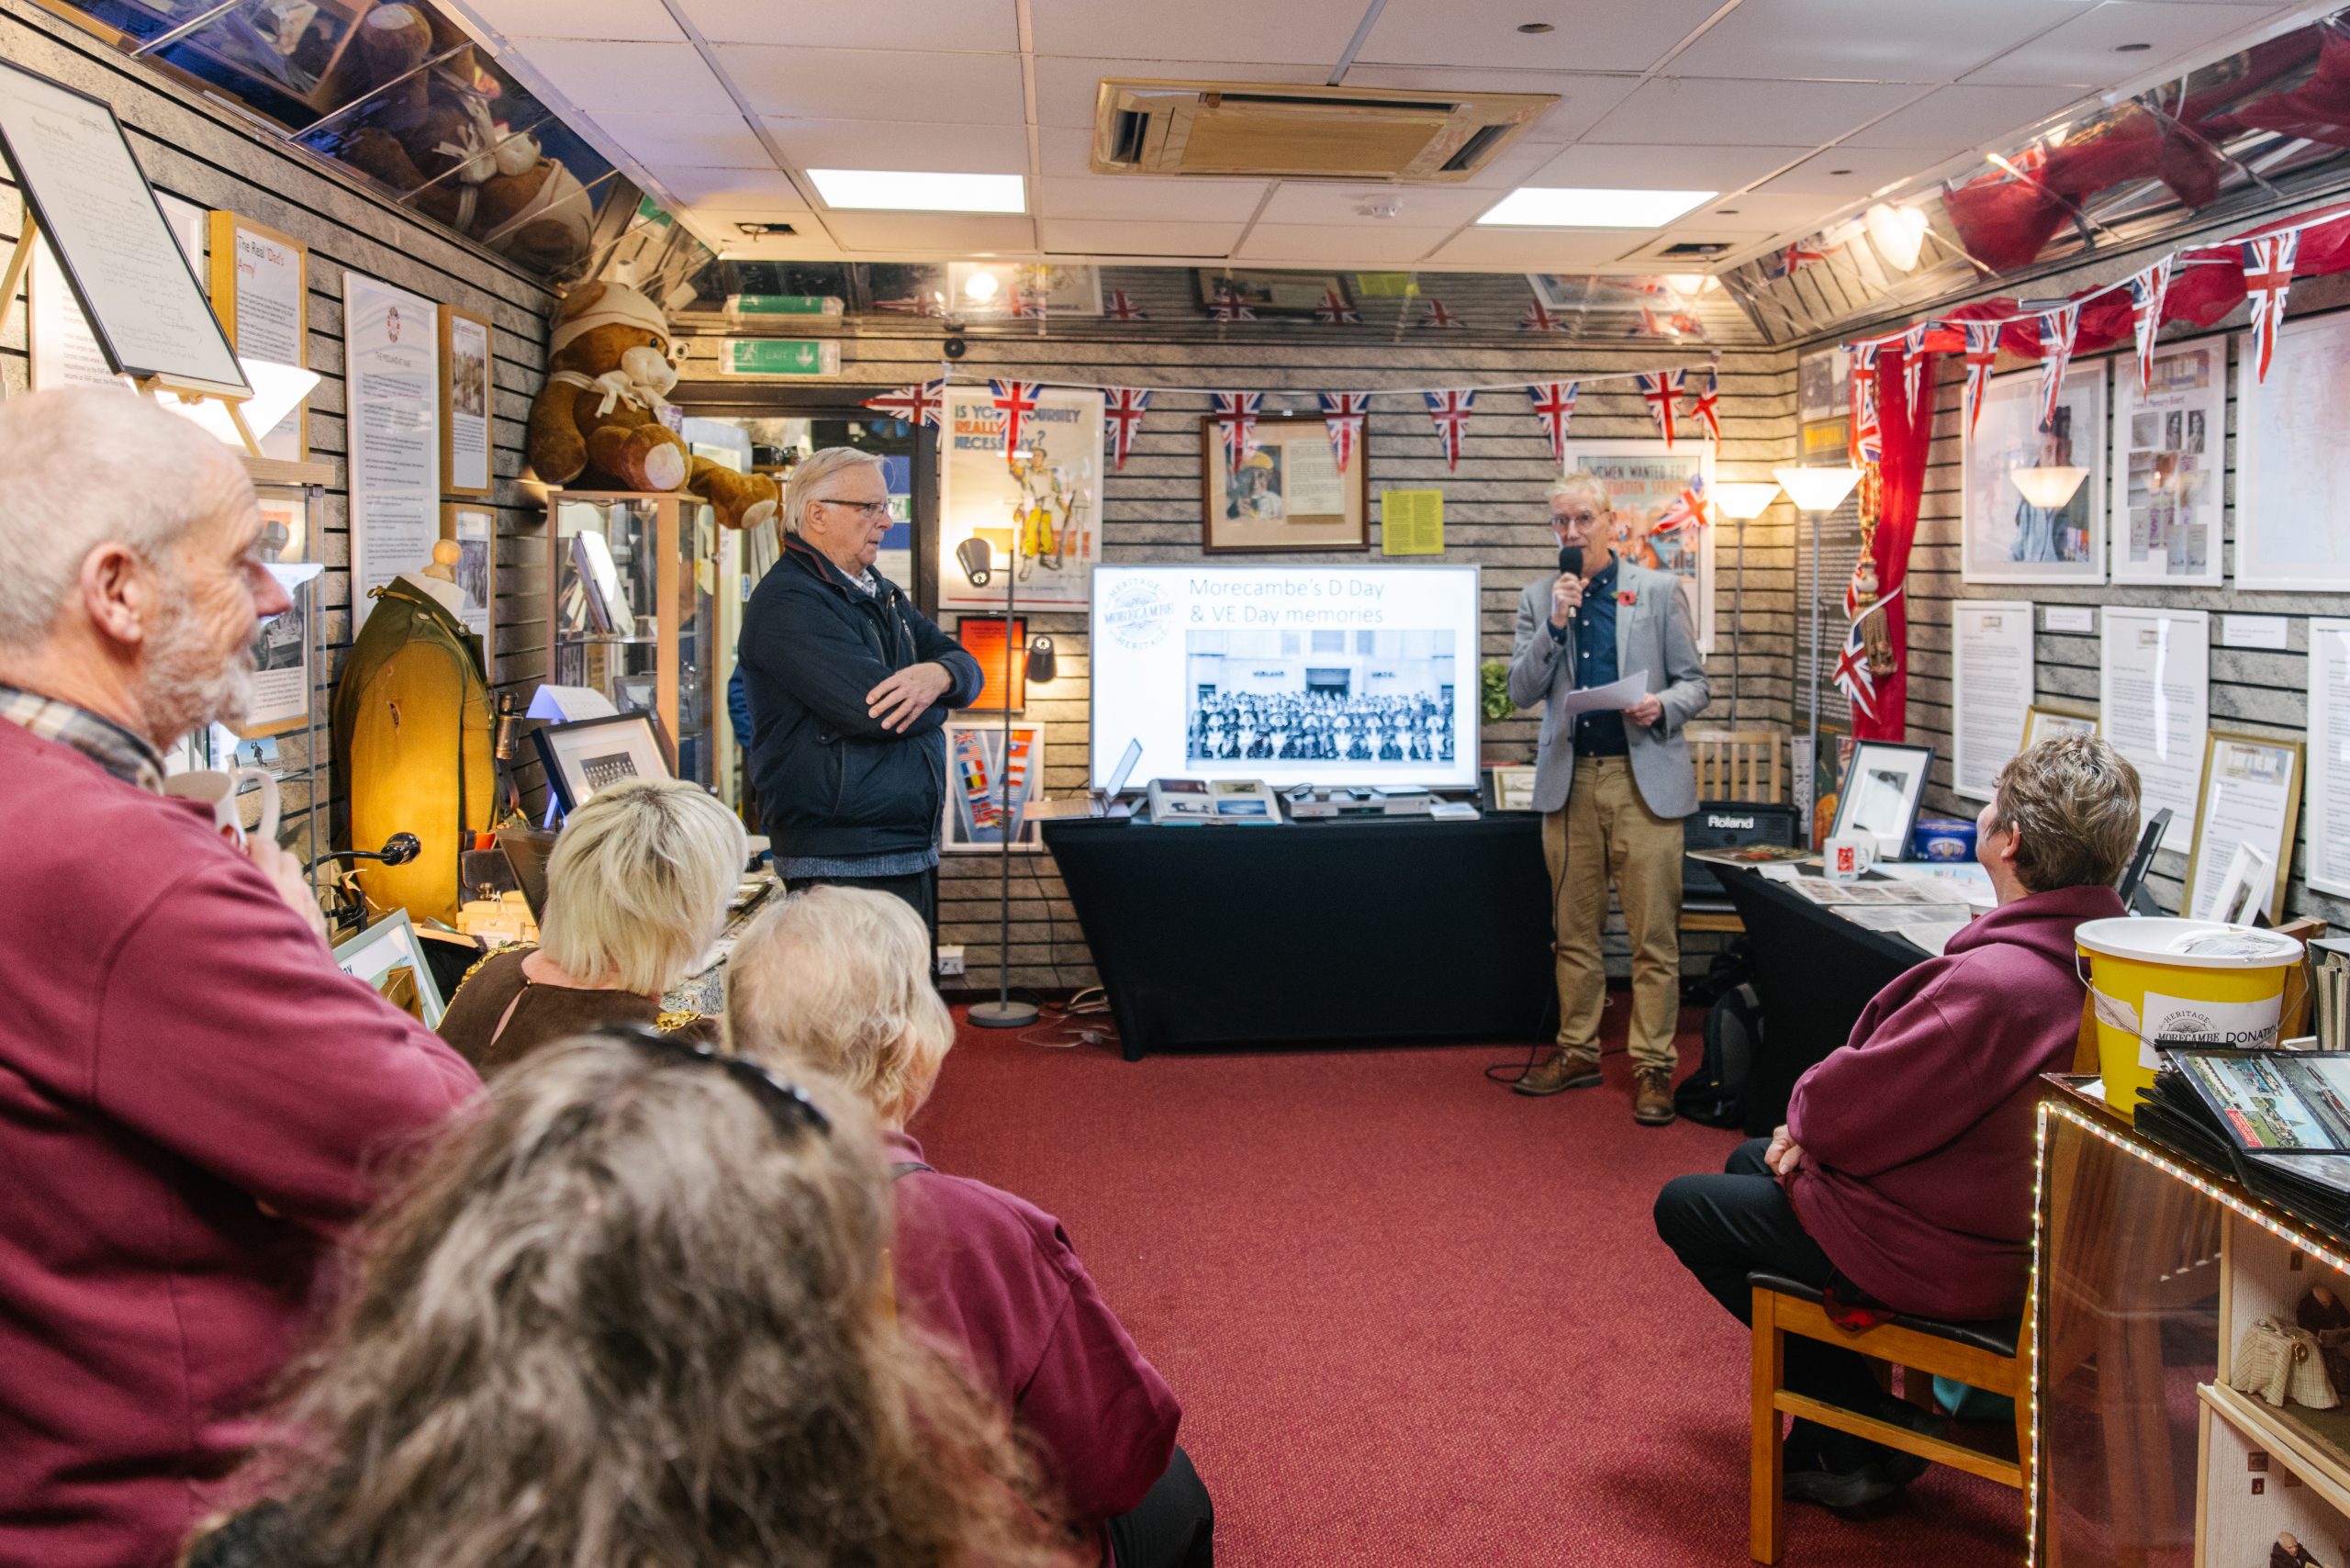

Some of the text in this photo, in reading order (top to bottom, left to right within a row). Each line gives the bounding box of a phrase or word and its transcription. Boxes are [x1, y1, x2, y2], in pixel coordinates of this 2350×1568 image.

[955, 405, 1081, 423] IS YO OURNEY
[1629, 465, 1666, 478] WANTED
[1190, 578, 1385, 599] Morecambe's D Day
[1190, 605, 1383, 625] & VE Day memories
[1708, 814, 1754, 829] Roland
[2165, 1011, 2210, 1024] HERITAGE
[2158, 1033, 2220, 1044] MORECAMBE
